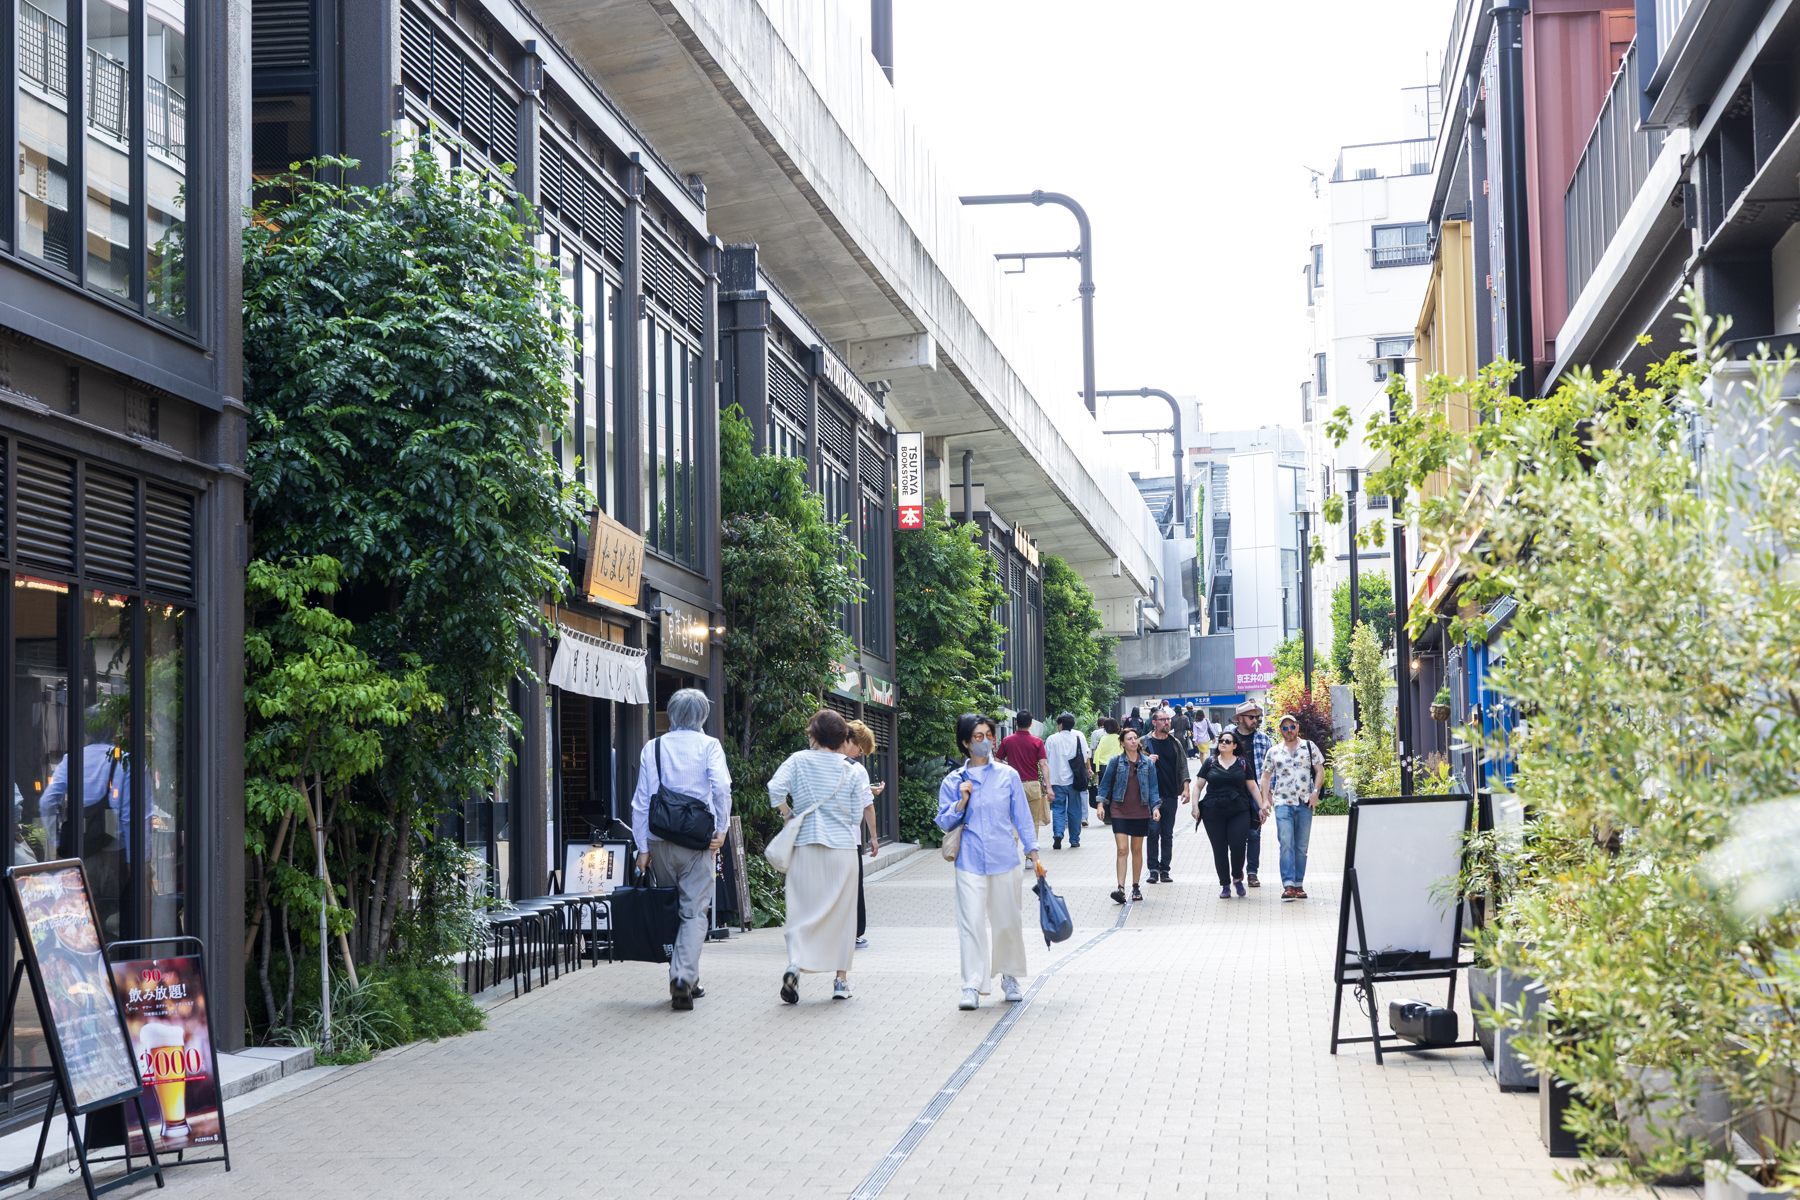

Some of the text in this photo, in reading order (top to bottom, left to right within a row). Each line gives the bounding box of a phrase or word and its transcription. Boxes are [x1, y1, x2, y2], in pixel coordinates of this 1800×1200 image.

[823, 346, 874, 425] TSUTAYA BOOKSTORE
[908, 446, 918, 496] TSUTAYA
[901, 507, 920, 526] 本
[597, 850, 607, 892] 分サイズ
[128, 982, 187, 1003] 飲み放題!
[140, 1047, 201, 1079] 2000
